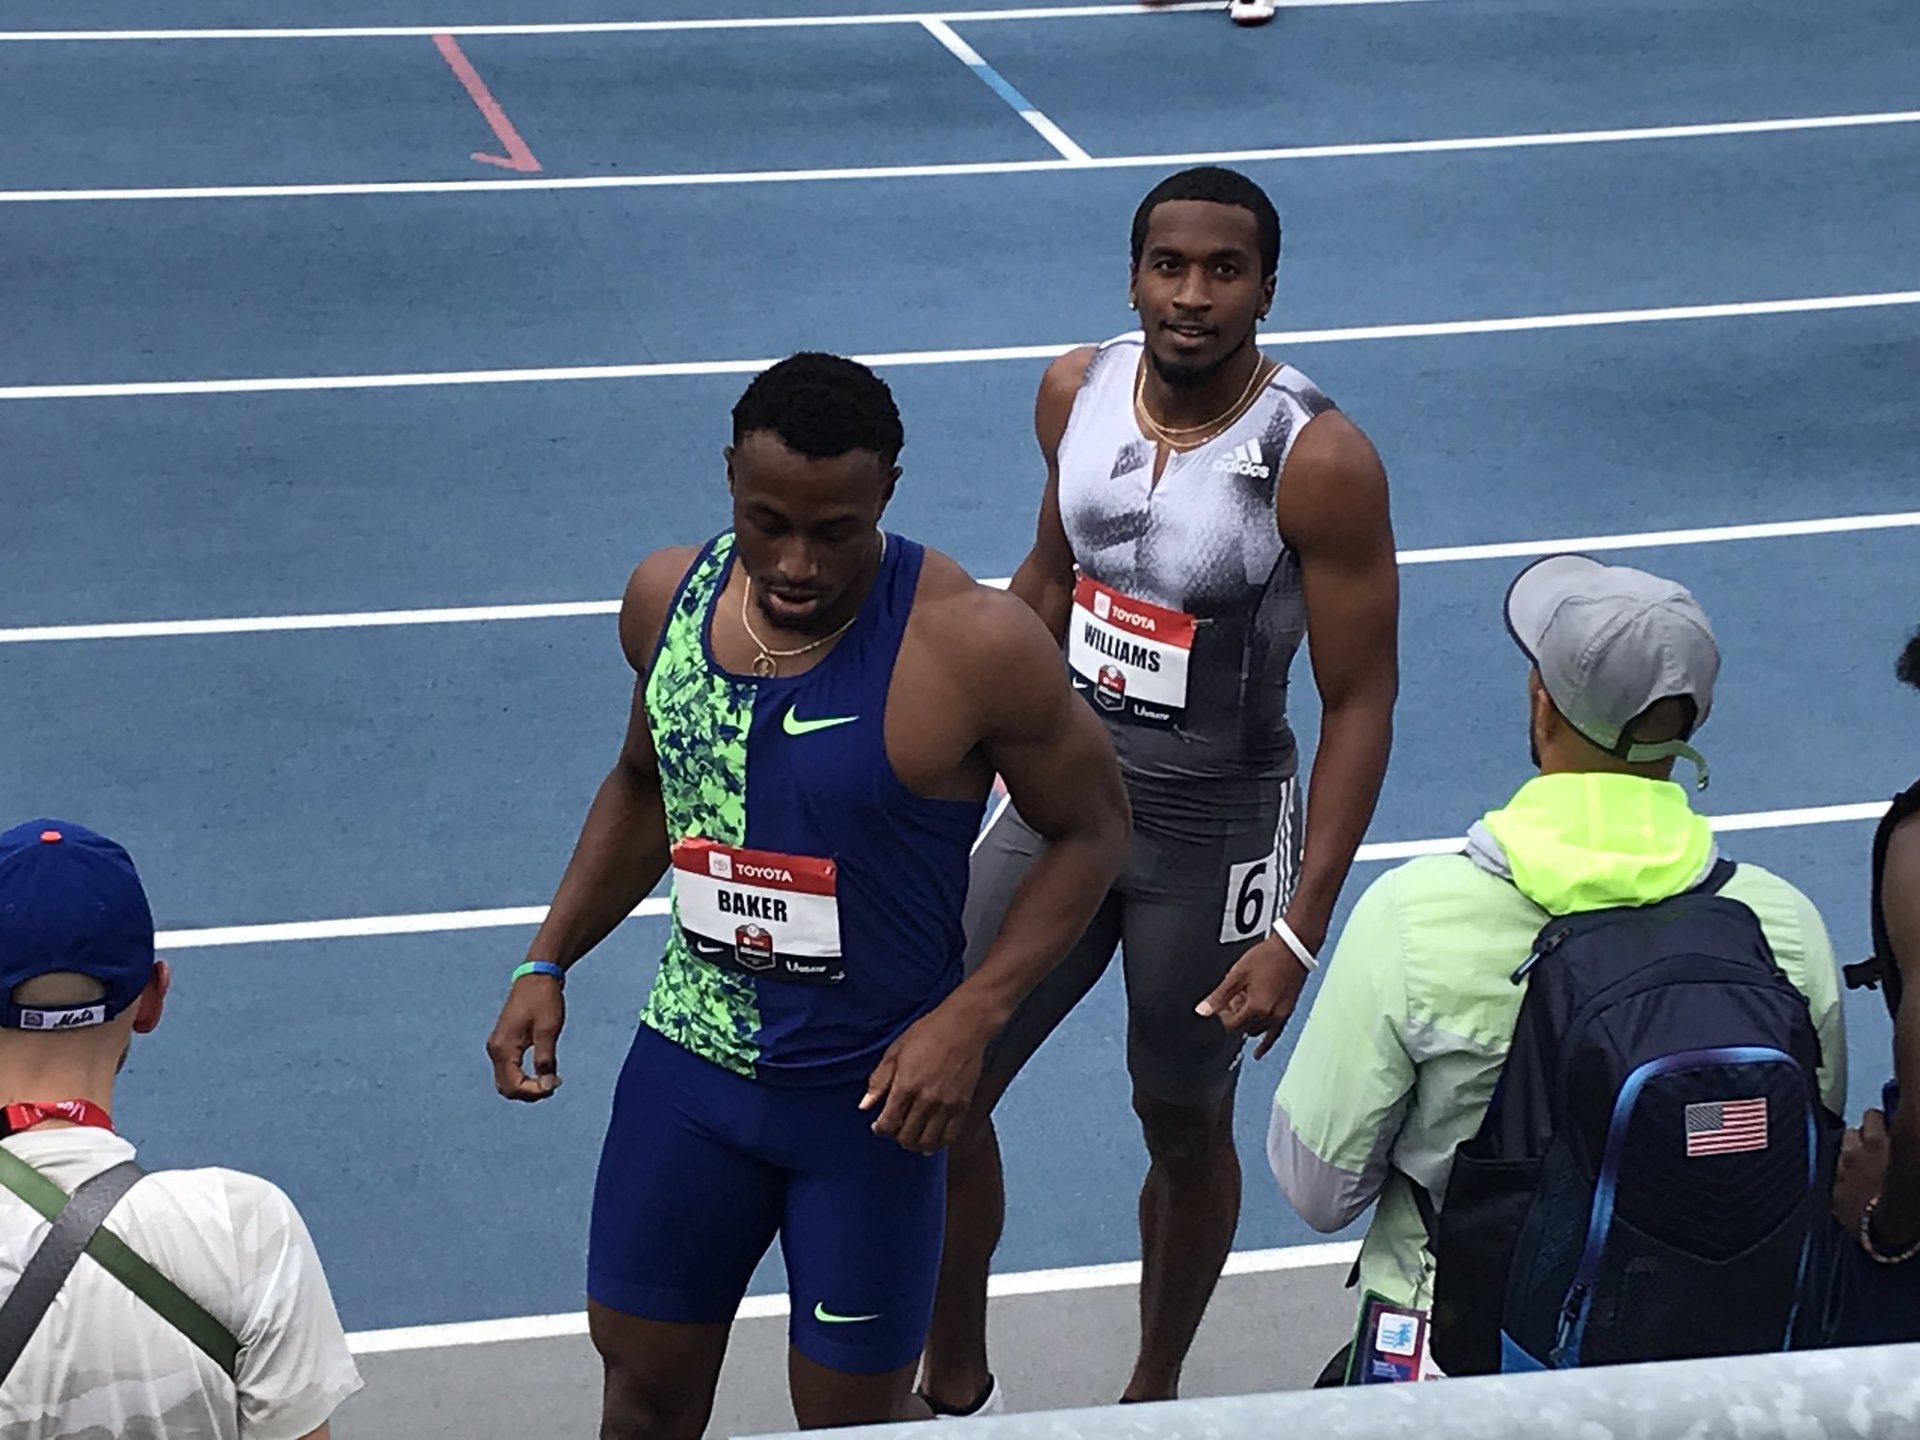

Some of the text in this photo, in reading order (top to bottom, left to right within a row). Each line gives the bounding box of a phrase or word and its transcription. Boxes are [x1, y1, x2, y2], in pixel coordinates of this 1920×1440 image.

[1212, 459, 1270, 478] adidas
[1112, 606, 1156, 631] TOYOTA
[1084, 621, 1161, 672] WILLIAMS
[736, 863, 793, 882] TOYOTA
[718, 889, 788, 922] BAKER
[1235, 862, 1267, 935] 6
[53, 1009, 95, 1028] Mets
